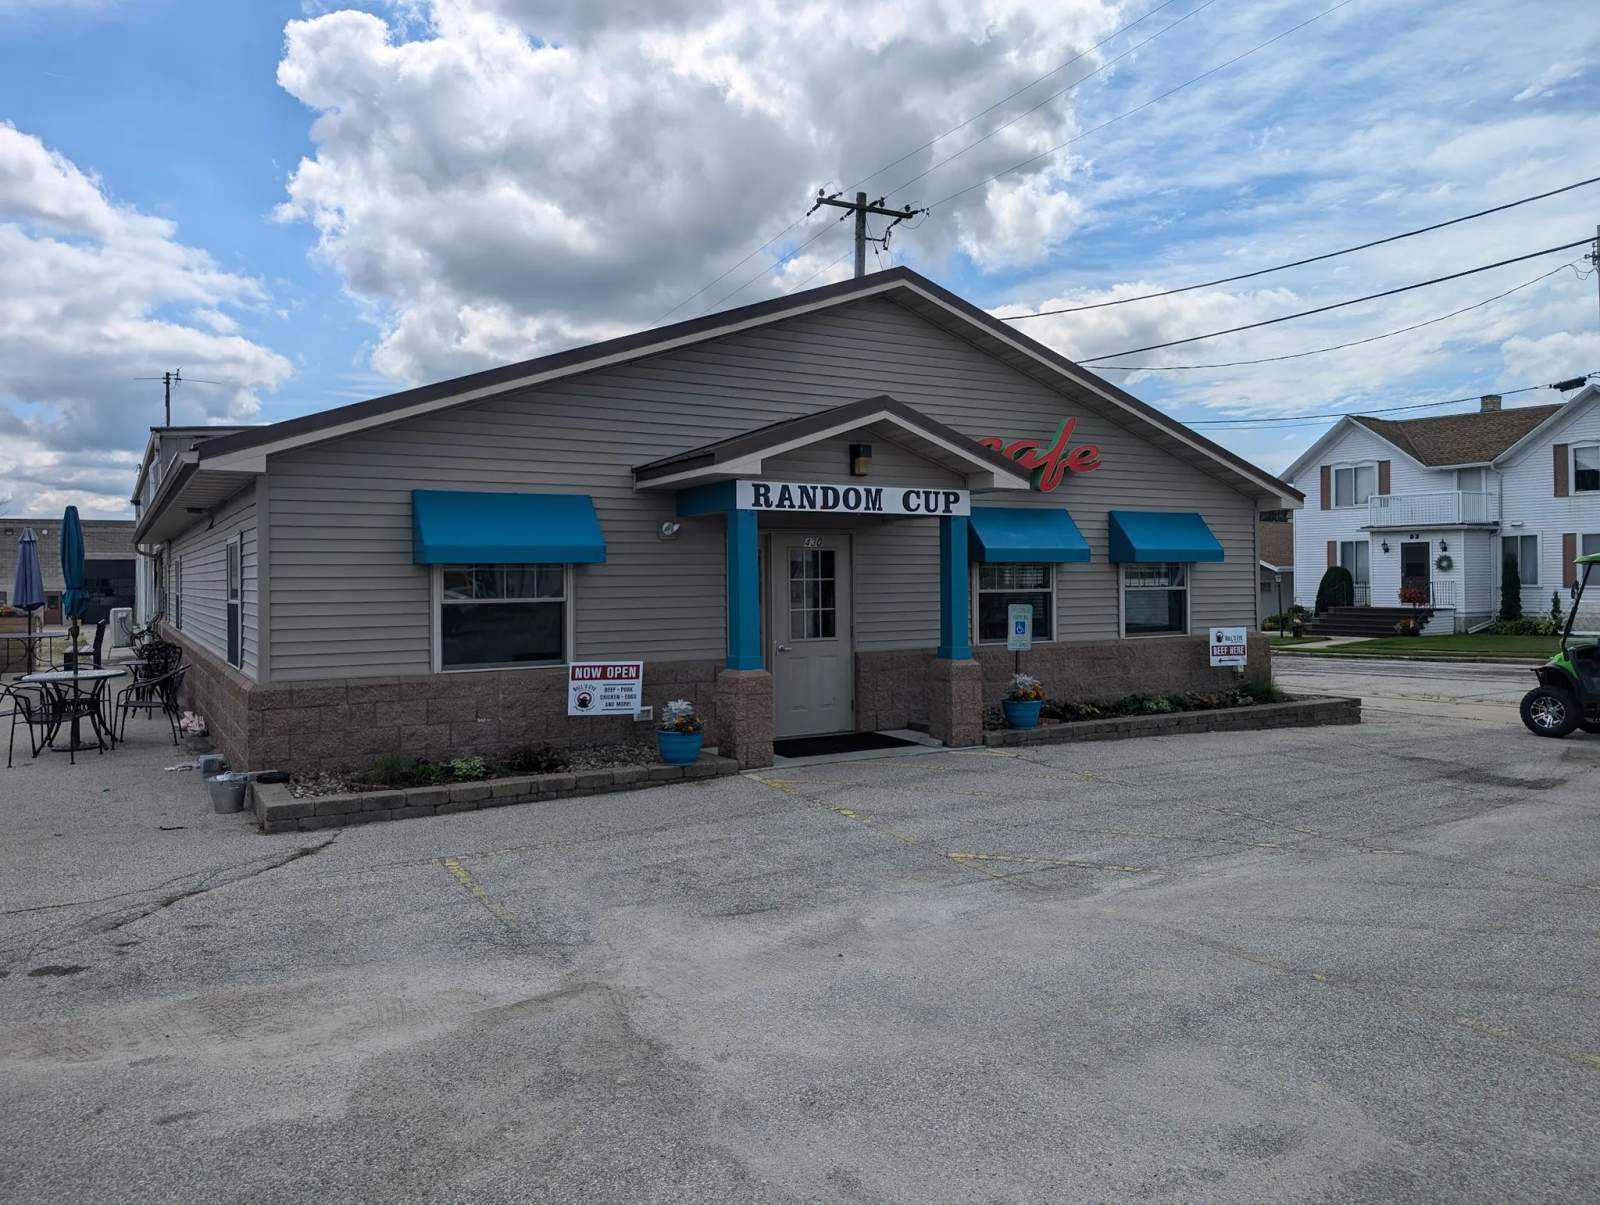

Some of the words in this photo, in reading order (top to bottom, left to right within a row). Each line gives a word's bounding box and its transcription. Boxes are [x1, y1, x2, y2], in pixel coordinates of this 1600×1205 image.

[751, 483, 883, 511] RANDOM
[902, 490, 960, 514] CUP
[1213, 646, 1228, 655] BEEF
[1229, 646, 1244, 655] HERE
[575, 667, 601, 679] NOW
[607, 666, 637, 678] OPEN
